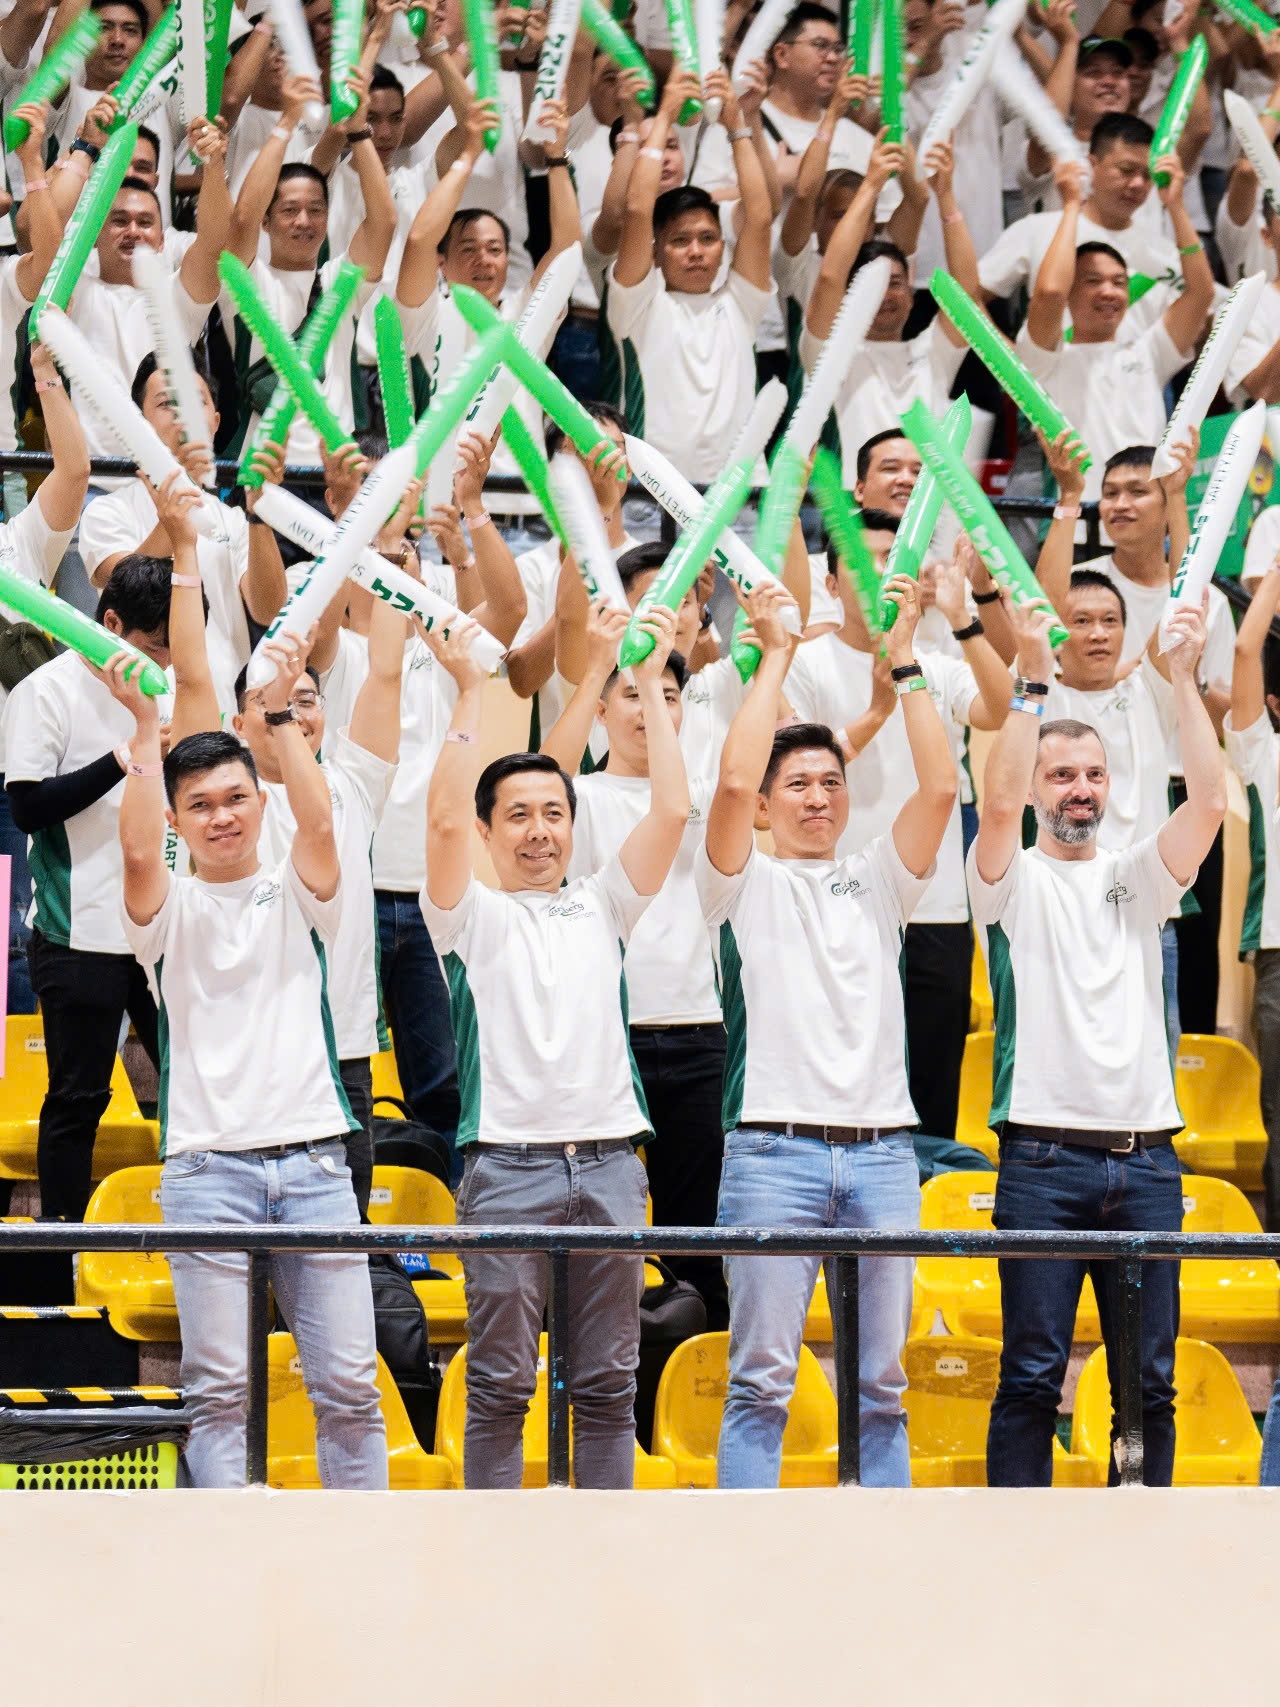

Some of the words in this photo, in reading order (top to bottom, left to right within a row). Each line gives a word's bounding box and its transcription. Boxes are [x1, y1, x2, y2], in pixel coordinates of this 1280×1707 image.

[640, 469, 662, 495] DAY
[1205, 459, 1231, 506] SAFETY
[1225, 432, 1241, 457] DAY
[288, 519, 317, 544] DAY
